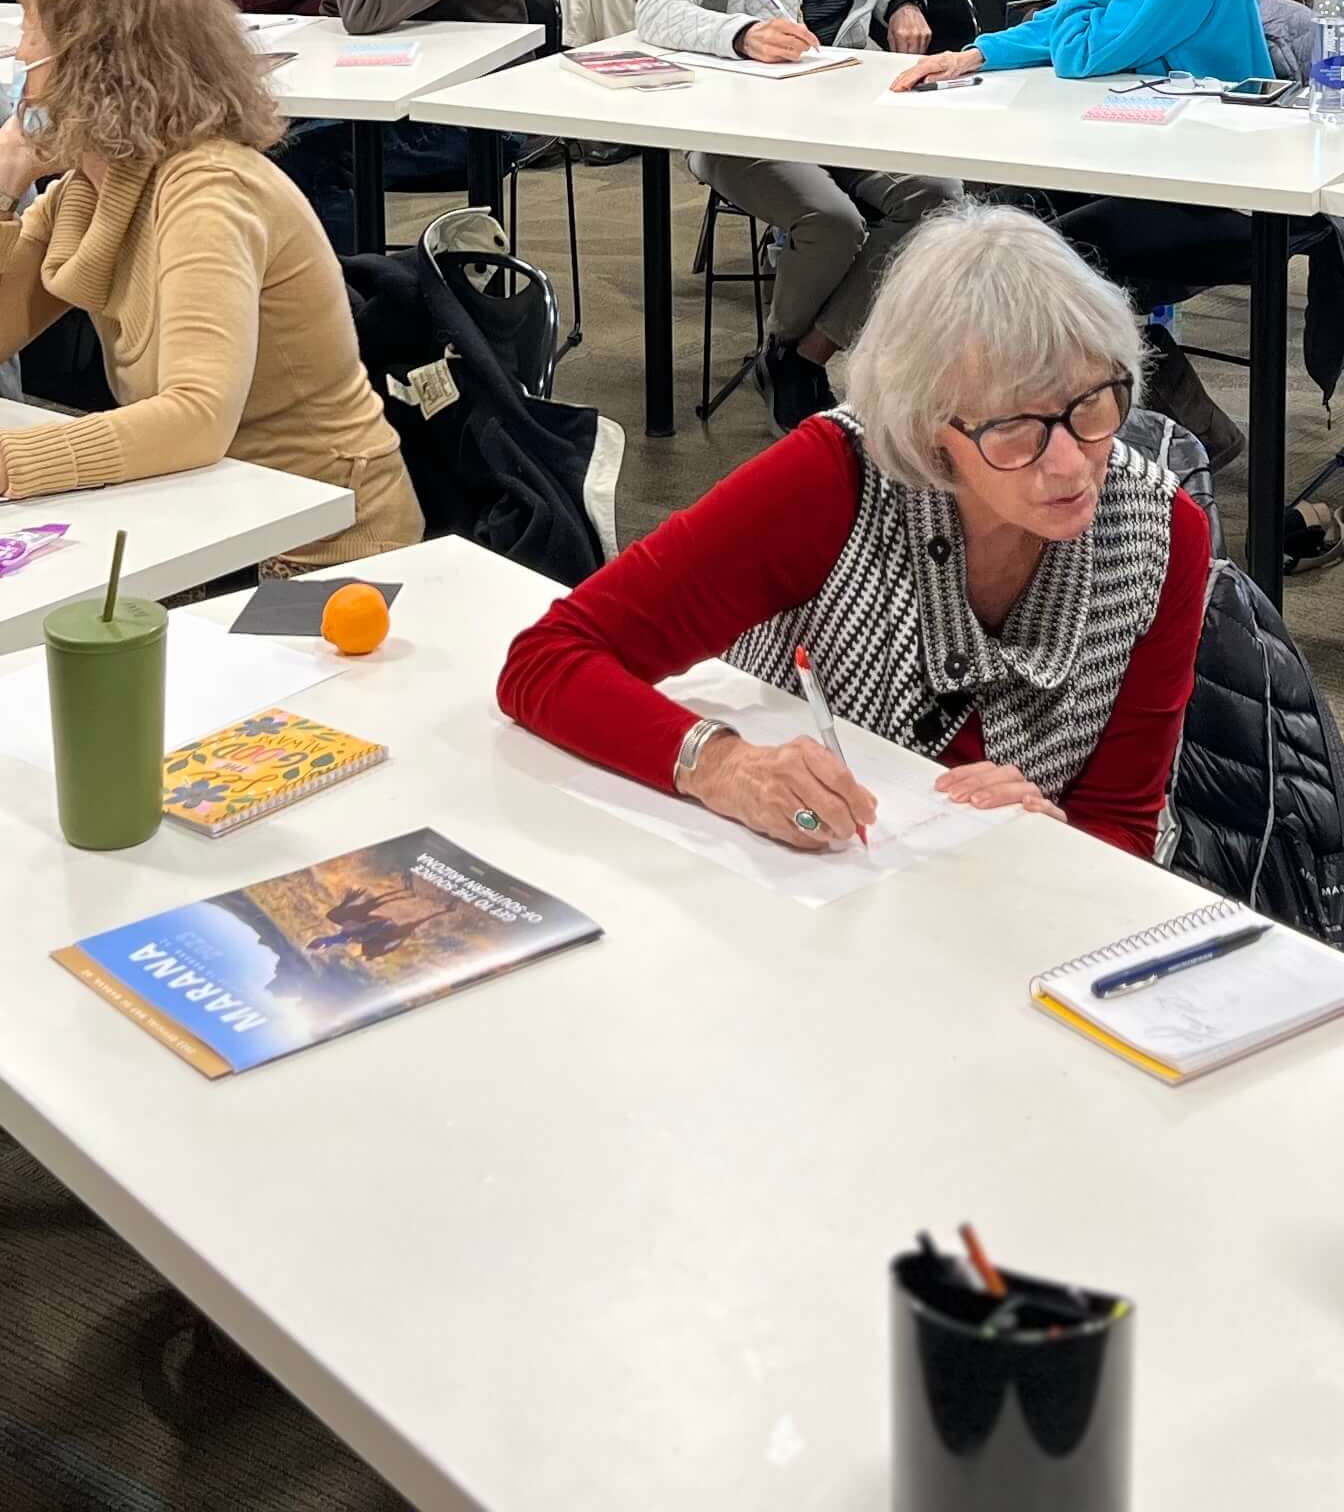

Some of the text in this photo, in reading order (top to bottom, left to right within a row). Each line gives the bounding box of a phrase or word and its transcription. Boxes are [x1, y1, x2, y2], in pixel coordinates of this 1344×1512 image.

[211, 742, 310, 769] GOOD
[416, 852, 473, 883] ARIZONA
[410, 863, 517, 922] GET TO THE SOURCE
[463, 879, 528, 913] SOUTHERN
[127, 941, 269, 1033] MARANA
